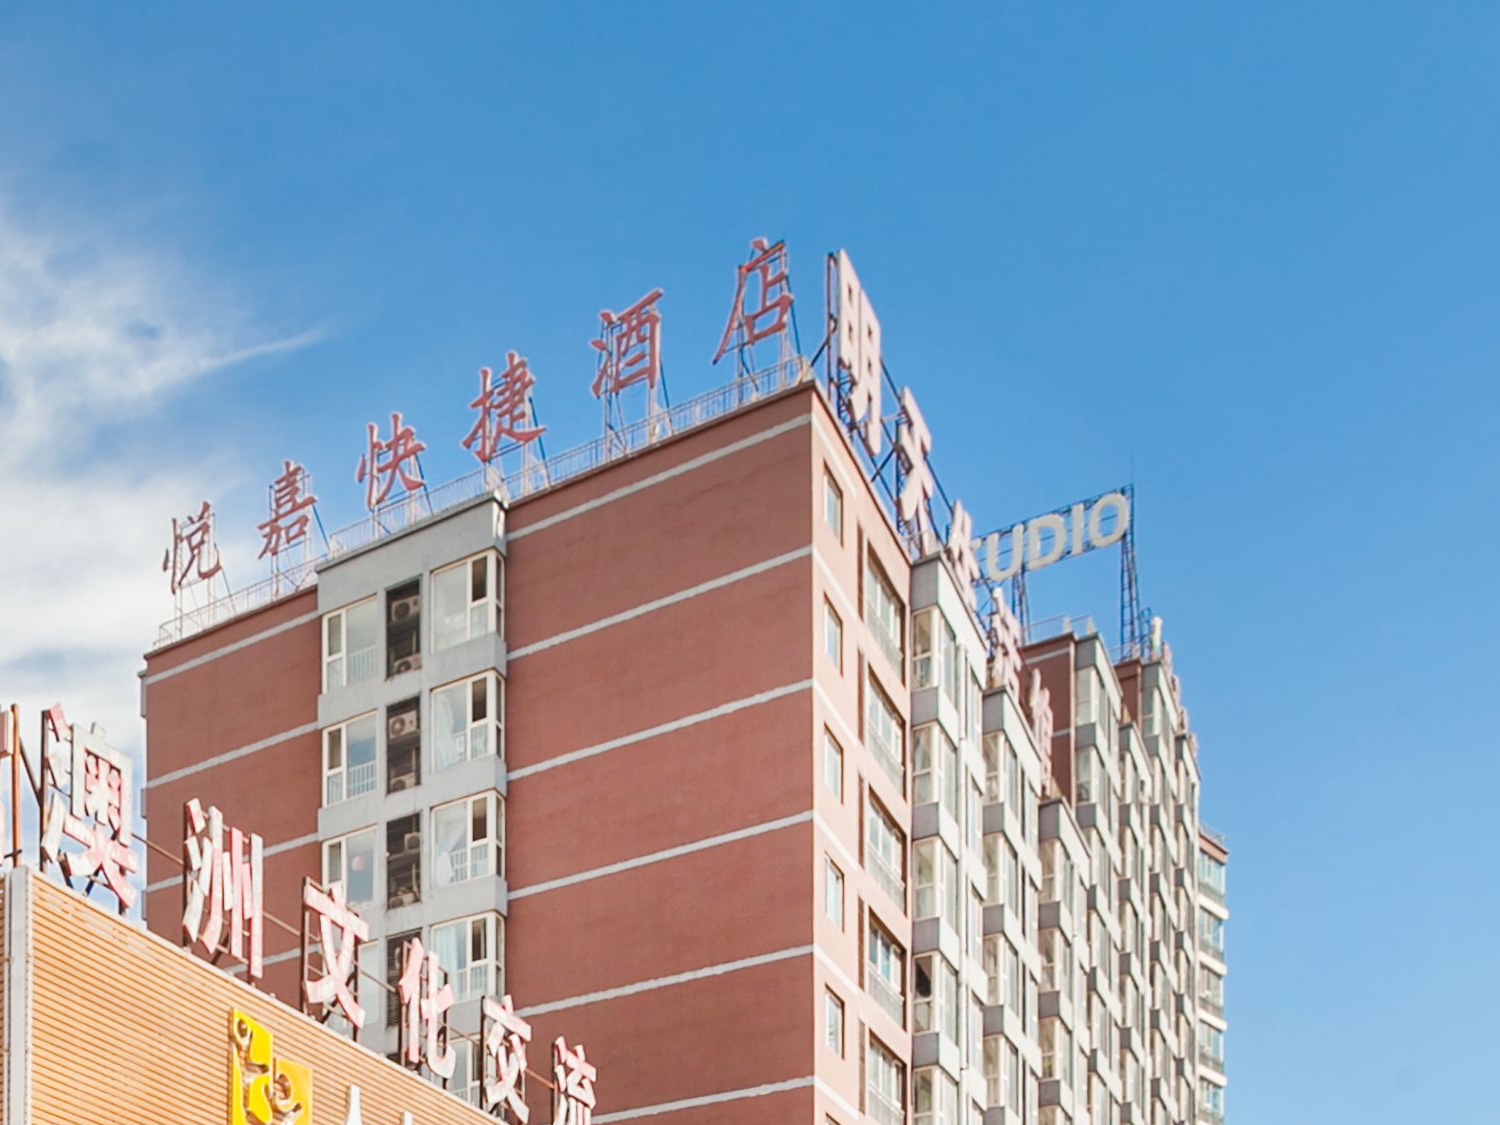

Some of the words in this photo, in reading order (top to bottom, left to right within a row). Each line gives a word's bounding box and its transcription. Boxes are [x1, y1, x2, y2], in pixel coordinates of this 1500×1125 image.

[162, 237, 793, 592] 悦嘉快捷酒店
[974, 491, 1130, 582] UDIO
